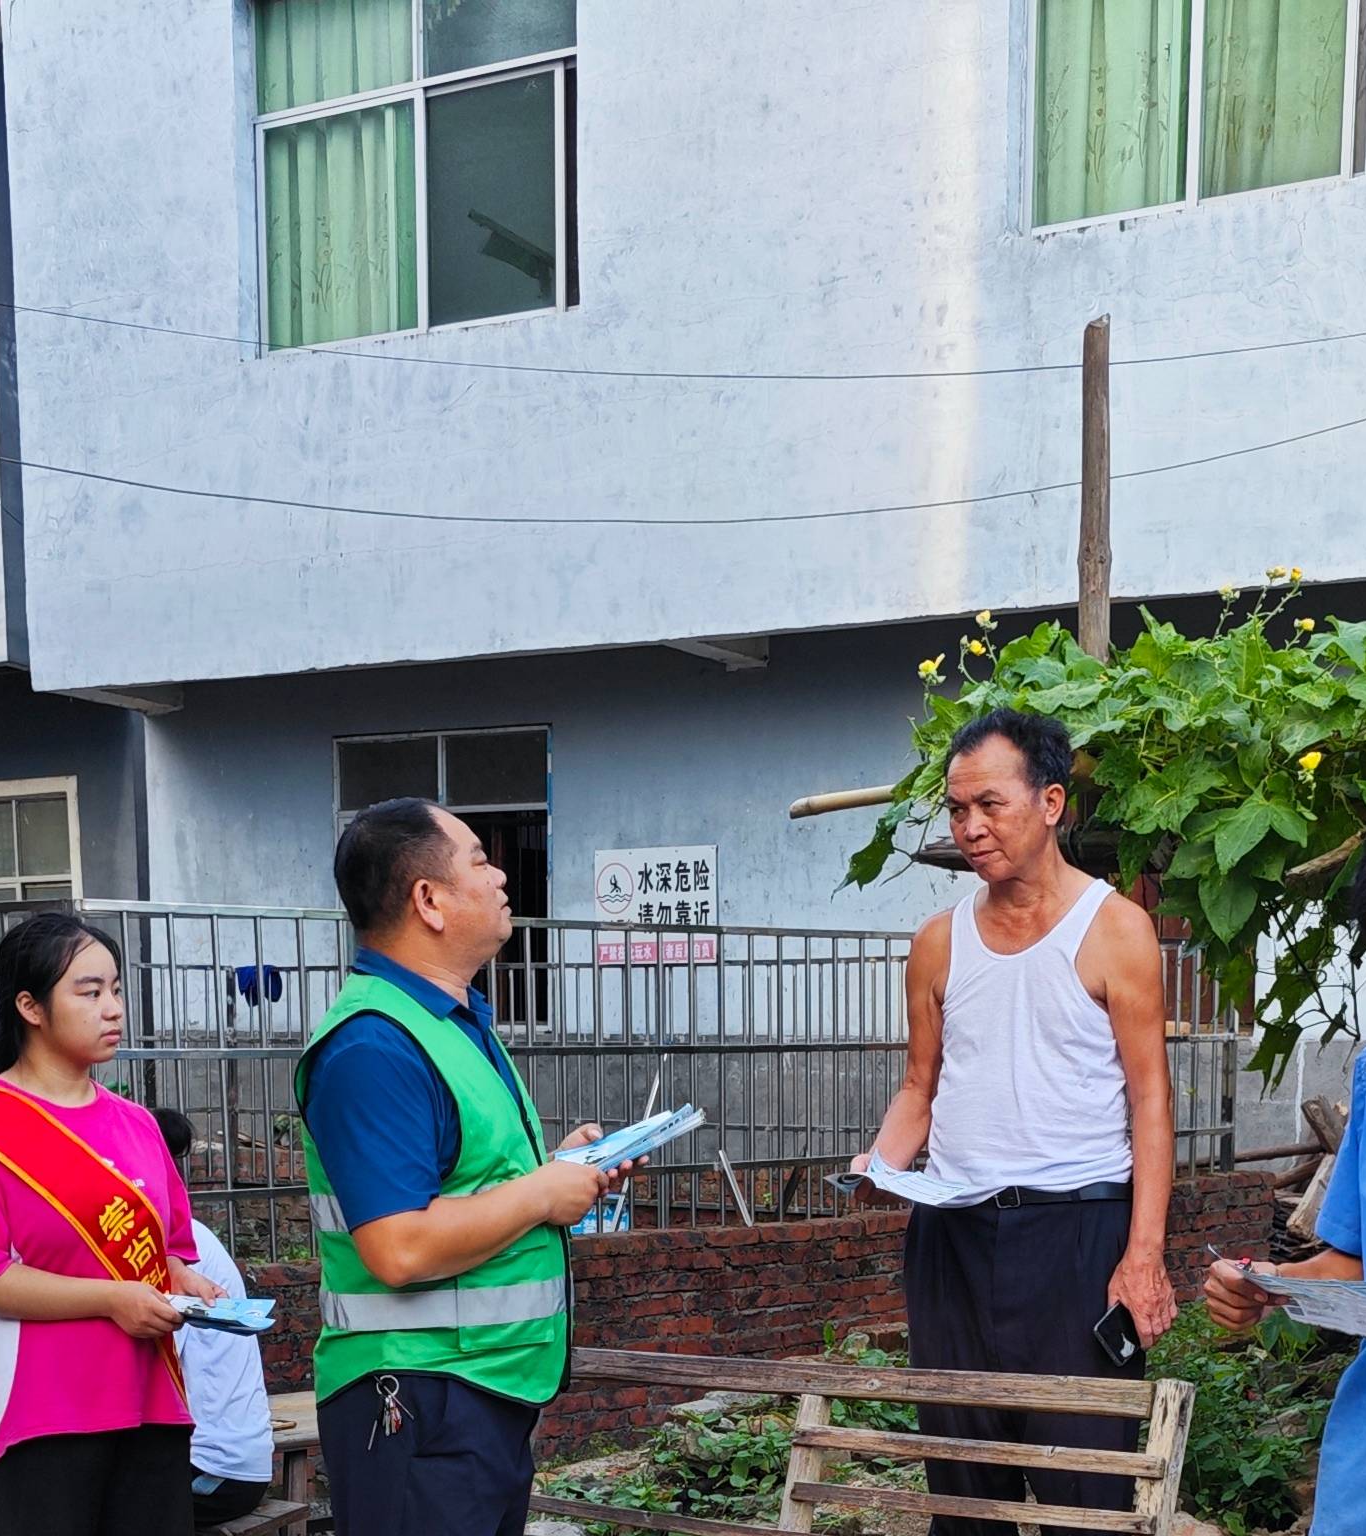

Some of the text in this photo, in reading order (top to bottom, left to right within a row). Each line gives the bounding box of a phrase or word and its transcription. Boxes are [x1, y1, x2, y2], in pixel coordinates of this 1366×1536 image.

[637, 859, 710, 894] 水深危险
[637, 900, 710, 931] 请勿靠近
